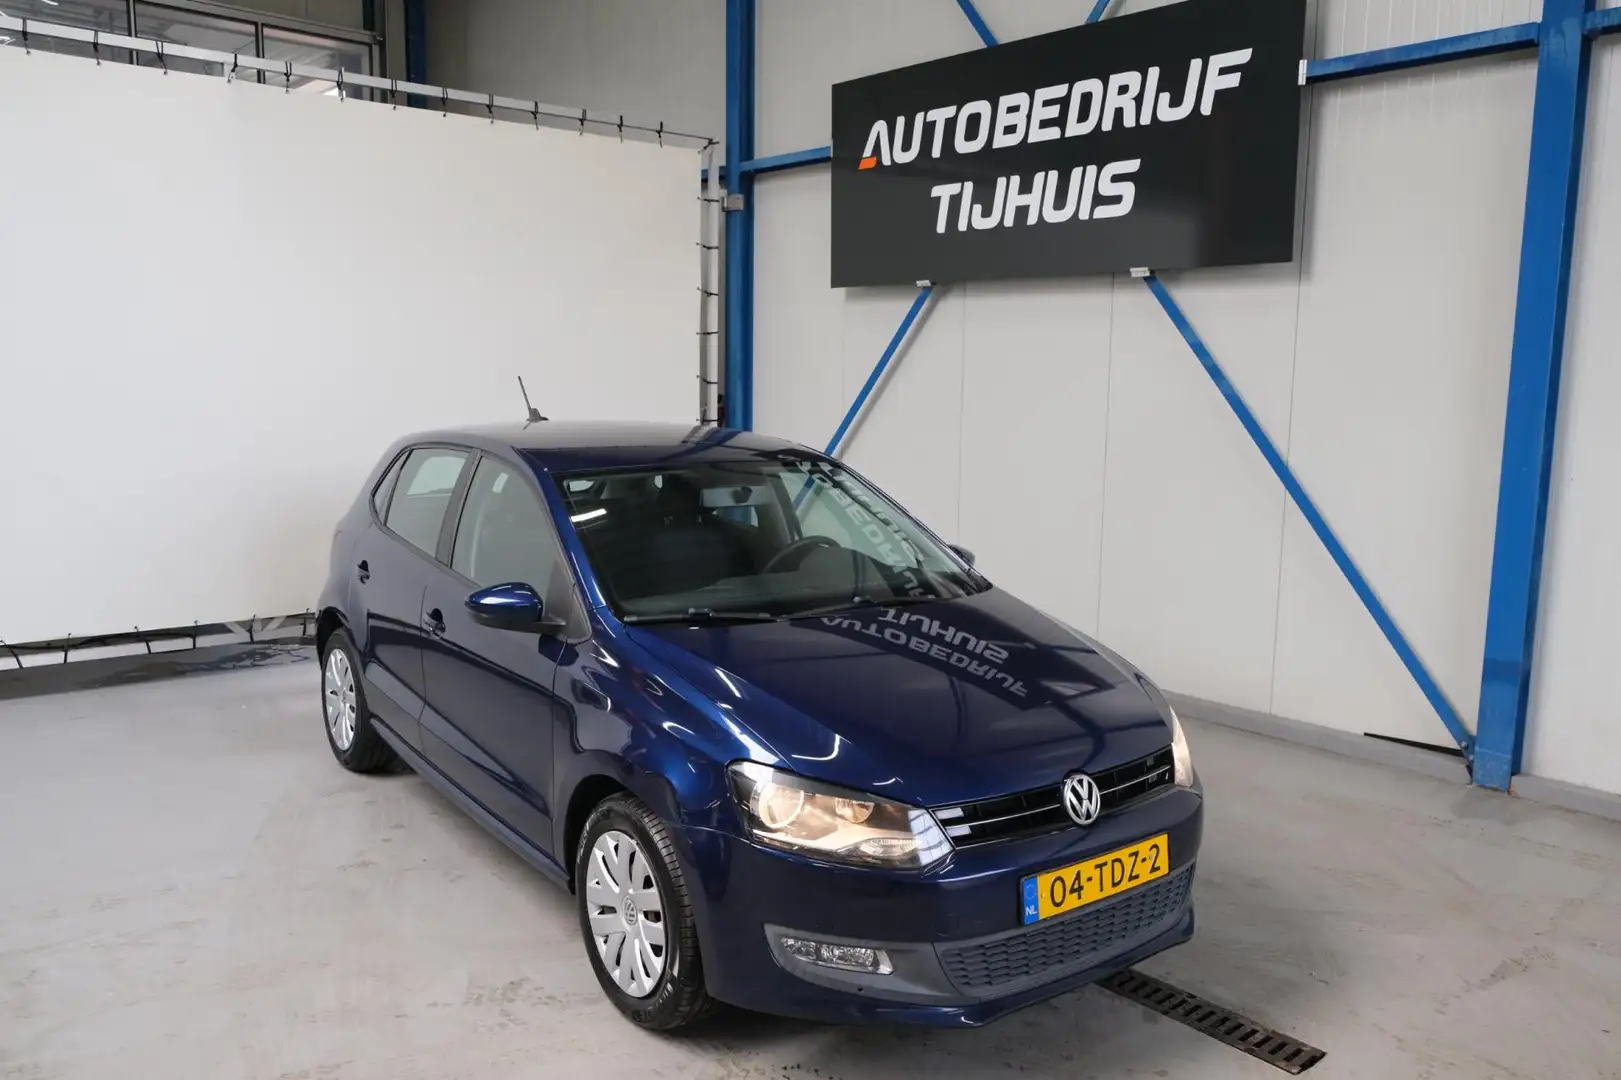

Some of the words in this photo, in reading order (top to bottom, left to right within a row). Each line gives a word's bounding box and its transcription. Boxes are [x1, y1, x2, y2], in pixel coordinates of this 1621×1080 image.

[858, 48, 1253, 170] AUTOBEDRIJF
[930, 158, 1141, 234] TIJHUIS
[1025, 905, 1038, 916] NL
[1050, 844, 1161, 908] 04-TDZ-2
